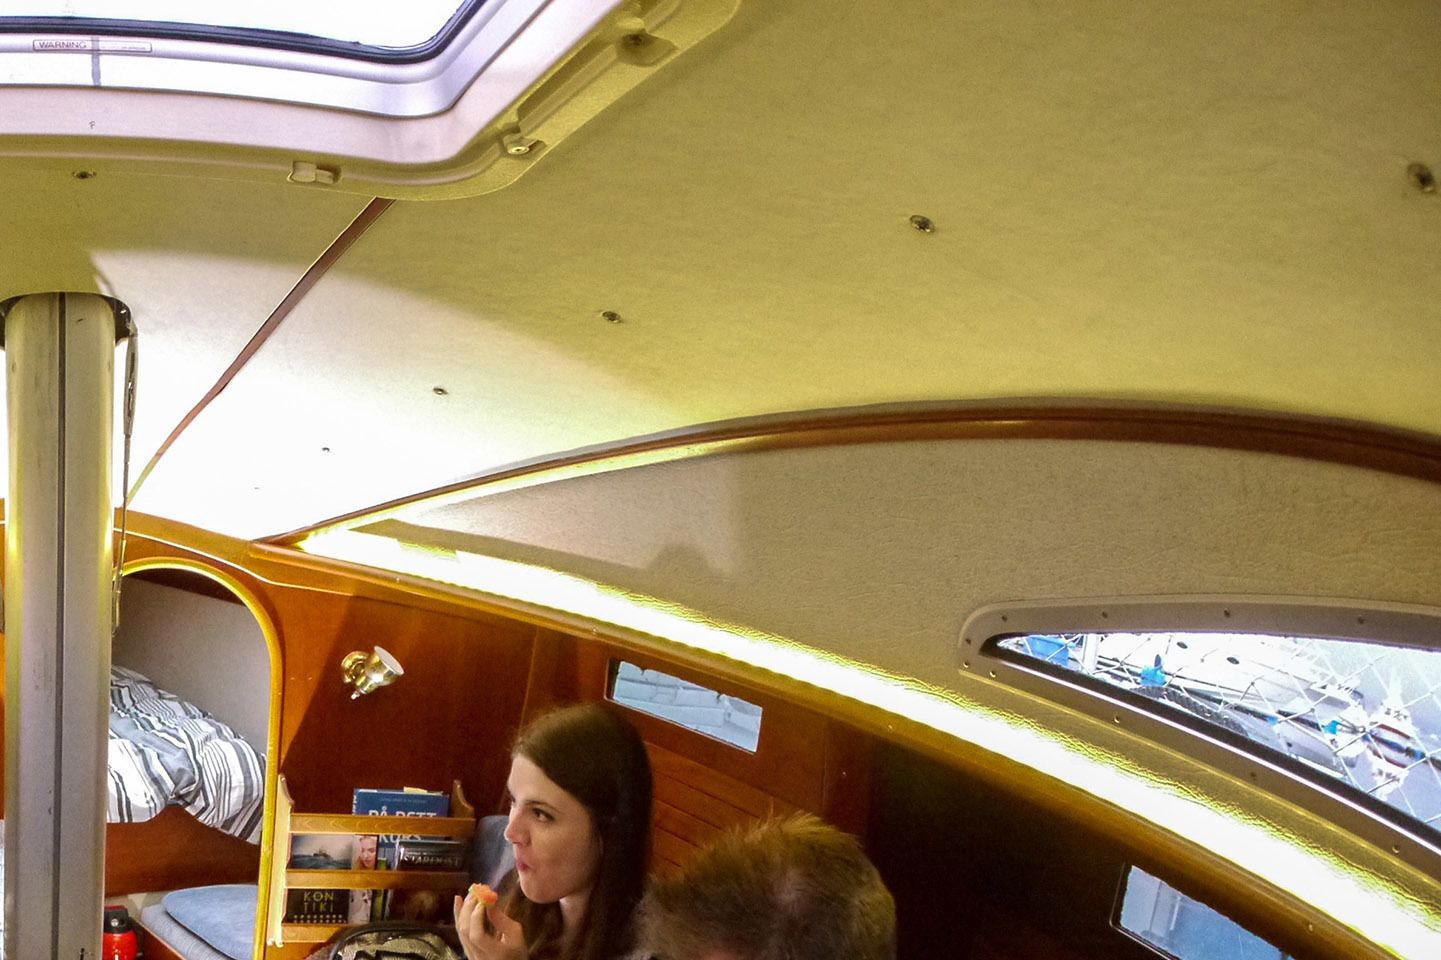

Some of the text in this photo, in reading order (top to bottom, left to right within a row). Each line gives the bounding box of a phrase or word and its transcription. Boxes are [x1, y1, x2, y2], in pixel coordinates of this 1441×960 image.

[39, 41, 87, 49] WARNING
[303, 891, 334, 902] KON
[303, 902, 334, 914] TIKI
